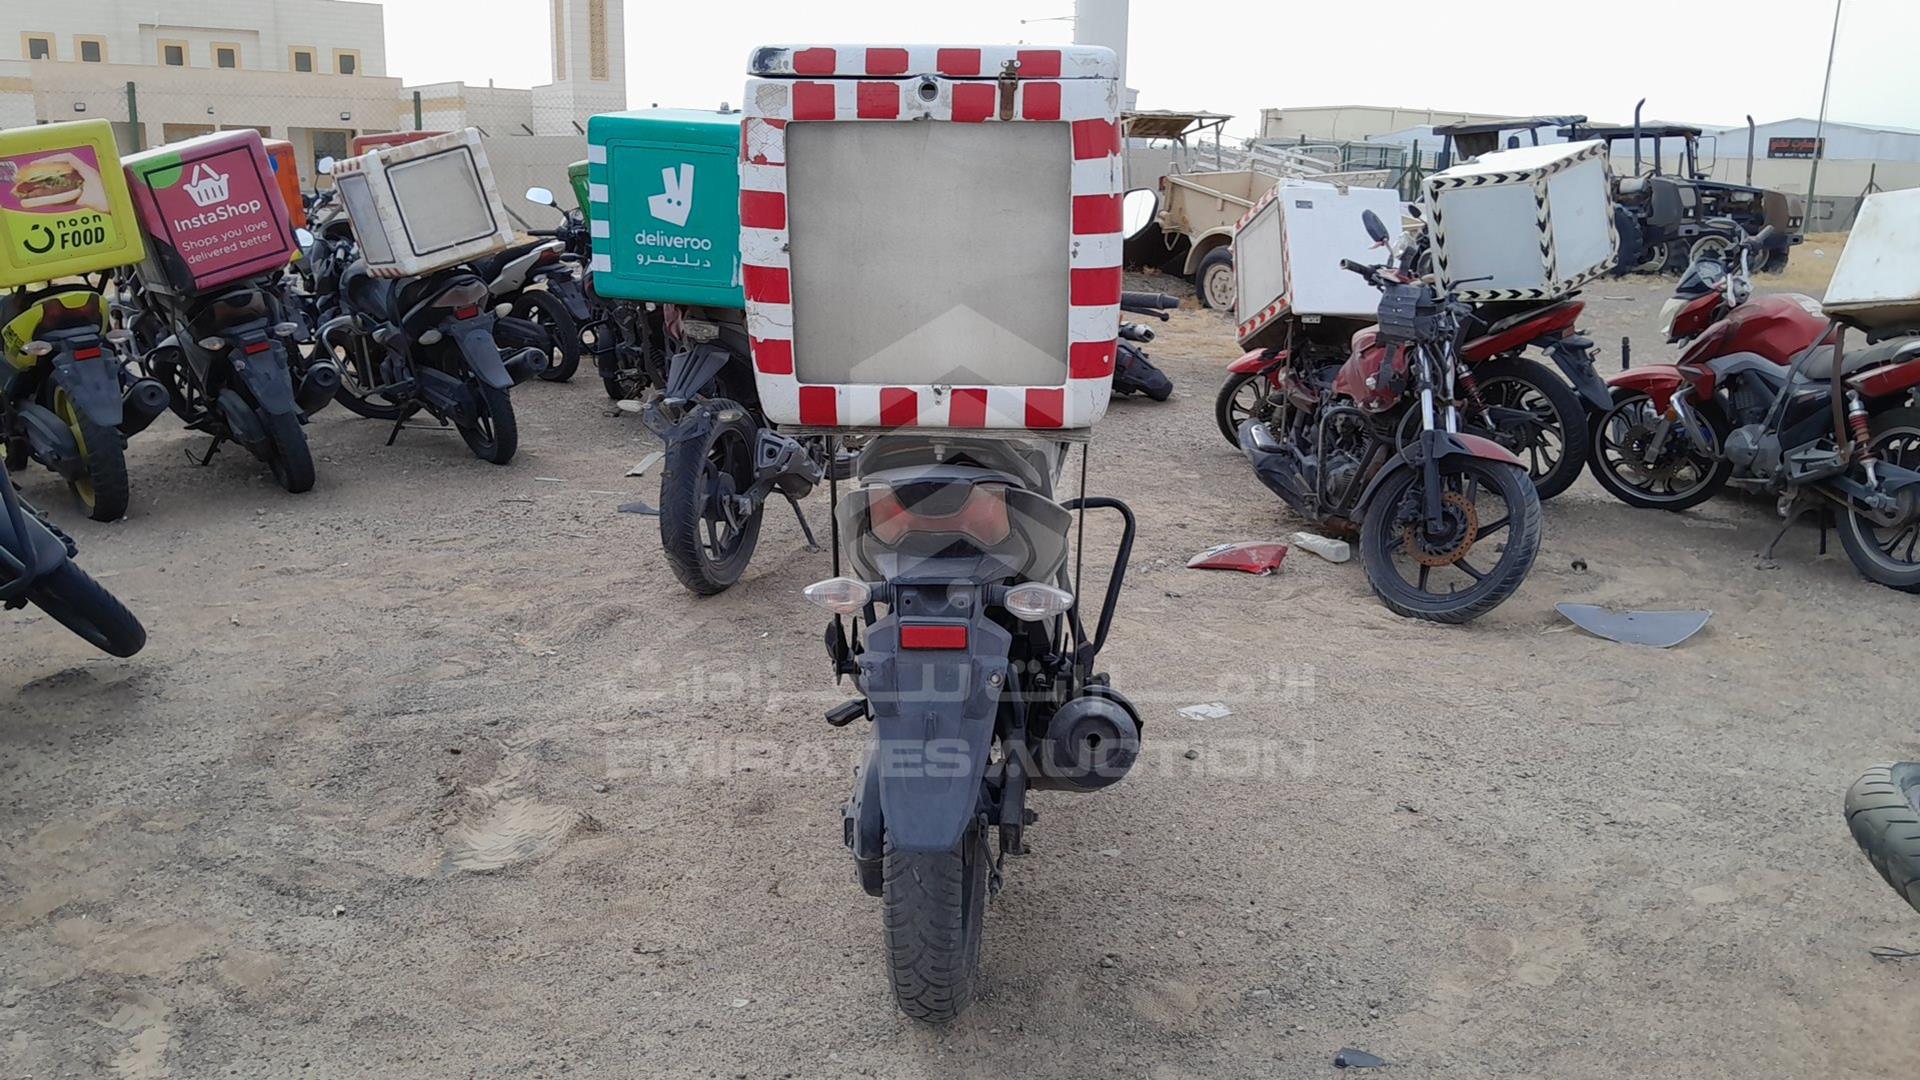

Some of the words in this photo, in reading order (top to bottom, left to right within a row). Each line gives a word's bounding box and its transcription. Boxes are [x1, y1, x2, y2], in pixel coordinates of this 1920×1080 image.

[56, 214, 103, 229] noon
[174, 200, 261, 232] InstaShop
[60, 226, 105, 250] FOOD
[182, 234, 219, 252] Shops
[220, 228, 242, 242] you
[244, 220, 268, 233] love
[188, 243, 238, 264] delivered
[239, 233, 272, 248] better
[635, 230, 712, 250] deliveroo
